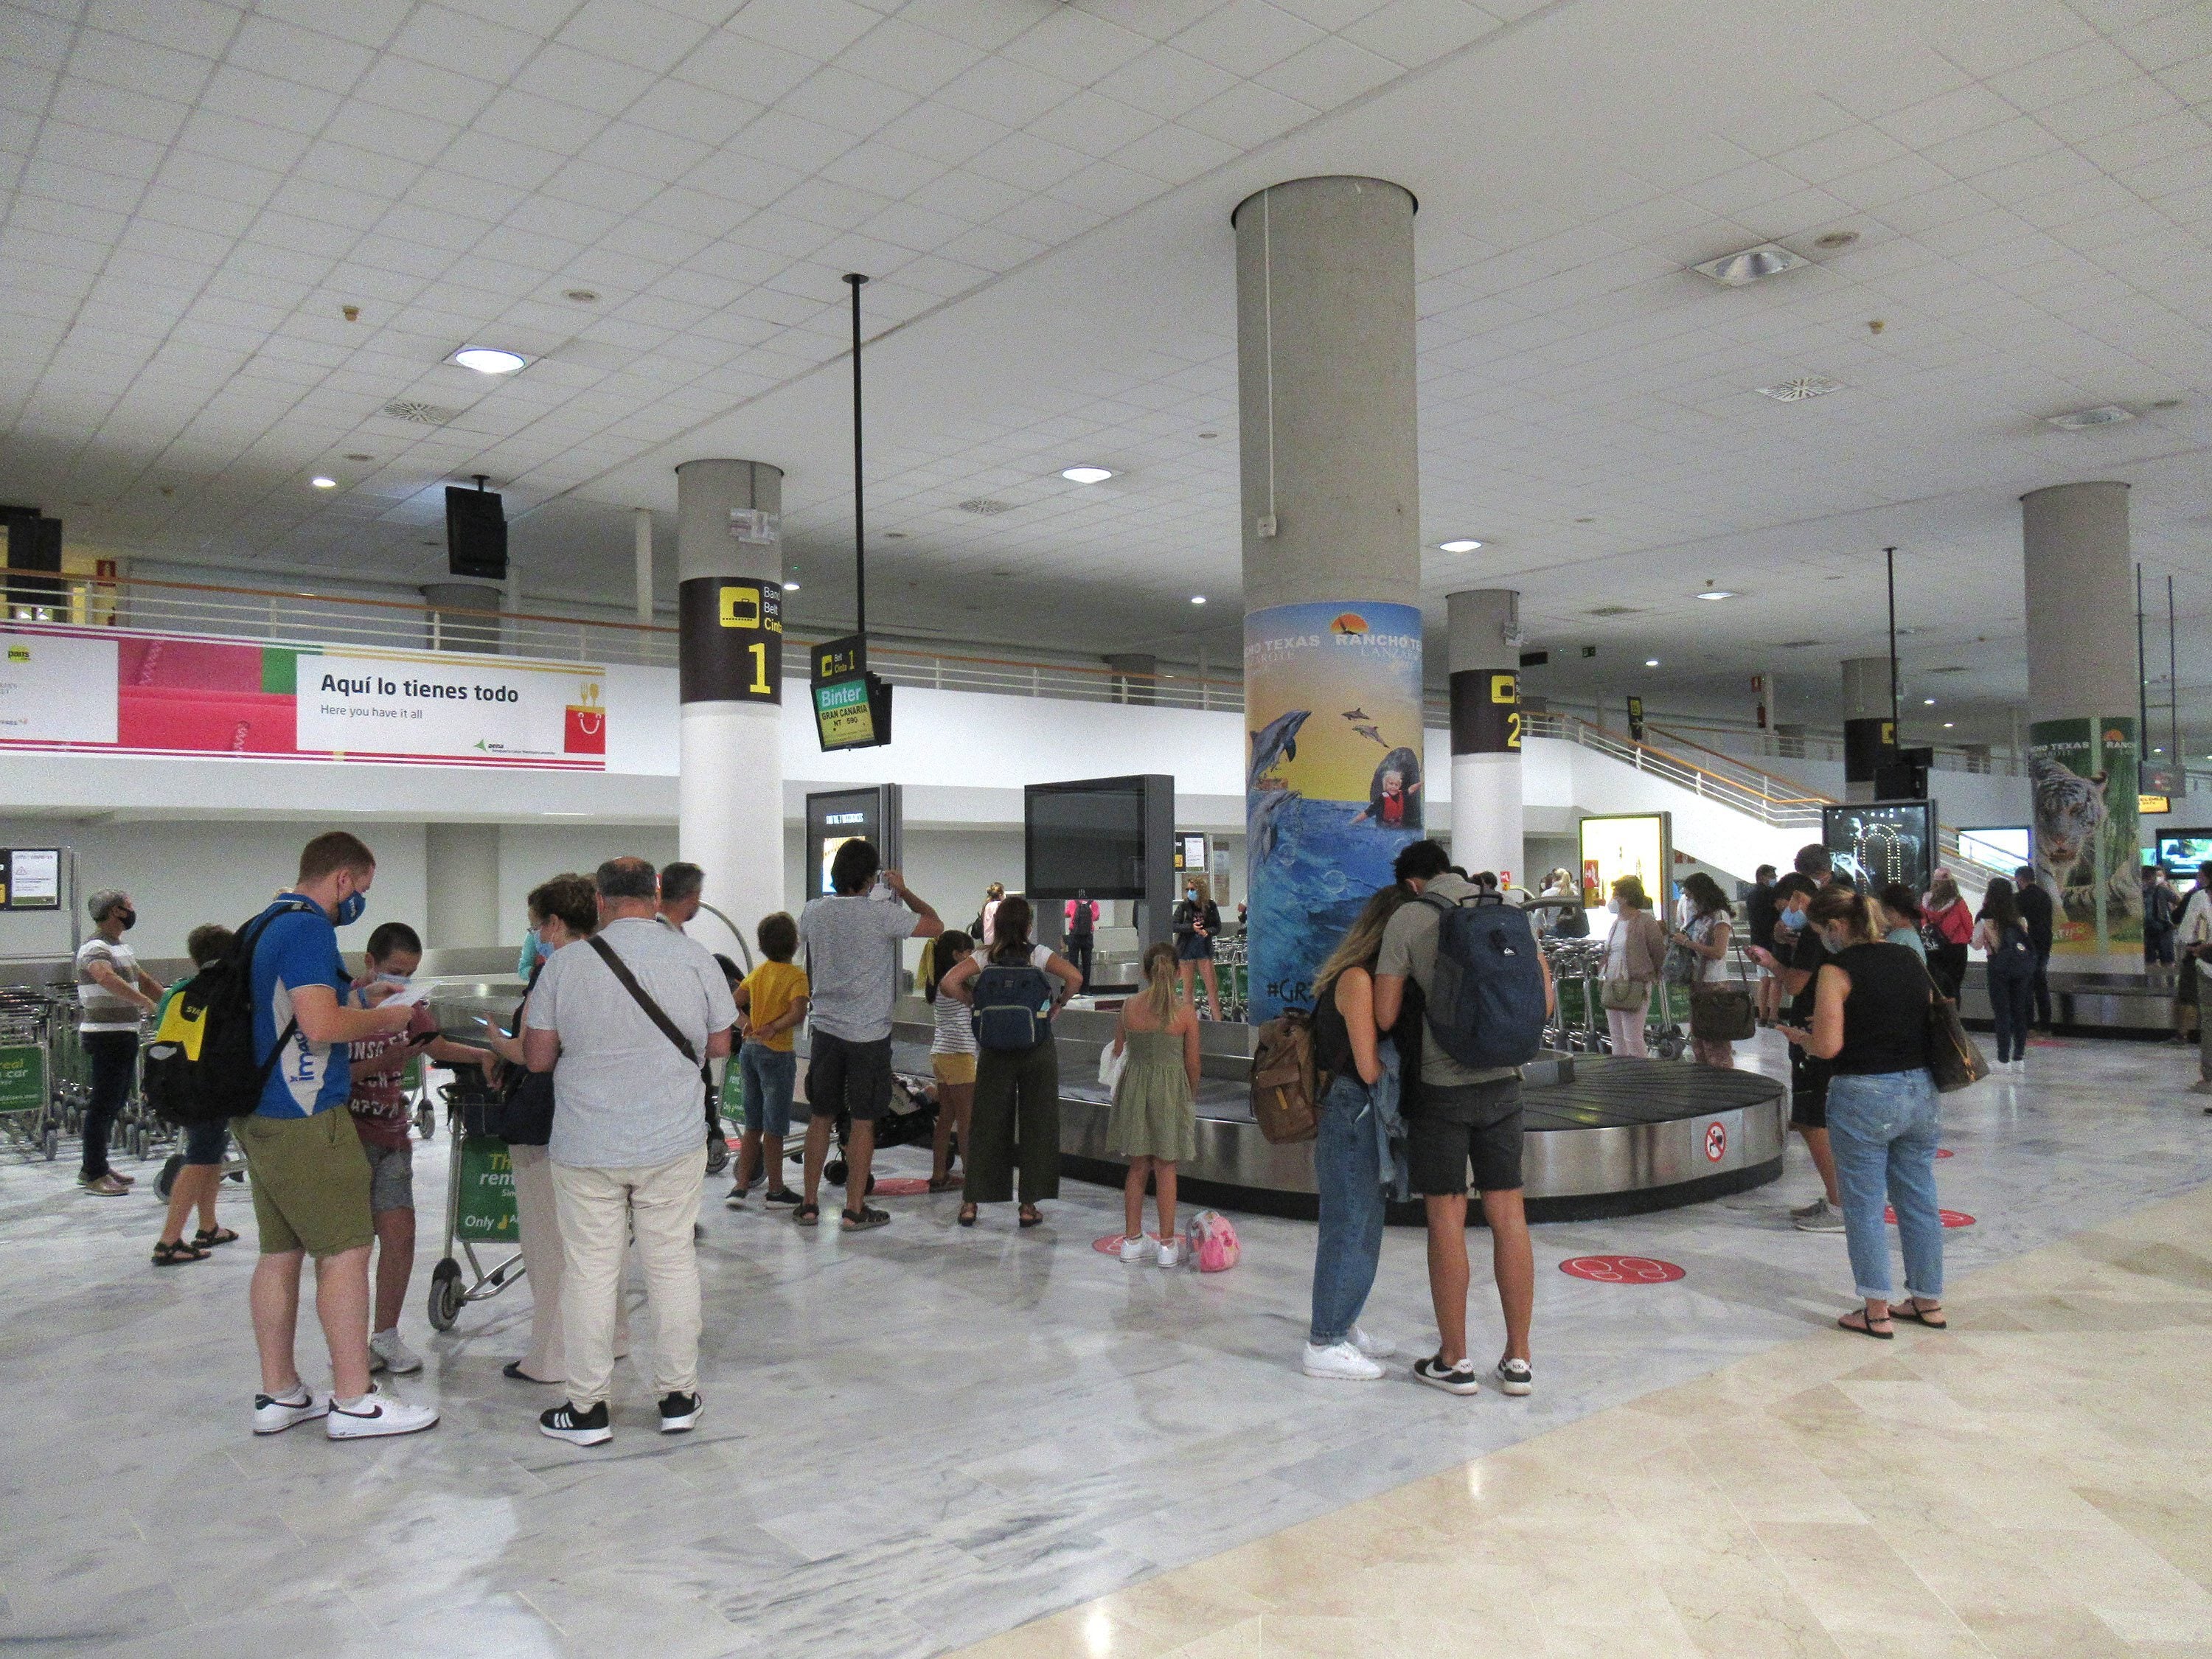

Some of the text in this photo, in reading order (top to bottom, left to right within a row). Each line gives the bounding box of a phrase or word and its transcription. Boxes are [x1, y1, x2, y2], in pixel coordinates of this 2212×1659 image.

[764, 602, 778, 616] Belt
[764, 617, 783, 634] Cinta
[1265, 635, 1321, 651] TEXAS
[1335, 634, 1407, 649] RANCHO
[748, 642, 771, 695] 1
[834, 650, 855, 673] Cinta 1
[321, 674, 519, 703] Aquí lo tienes todo
[821, 686, 862, 707] Binter
[321, 704, 422, 720] Here you have it all
[821, 704, 868, 720] GRAN CANARIA
[1507, 712, 1521, 748] 2
[7, 1069, 29, 1078] car
[465, 1214, 495, 1231] Only
